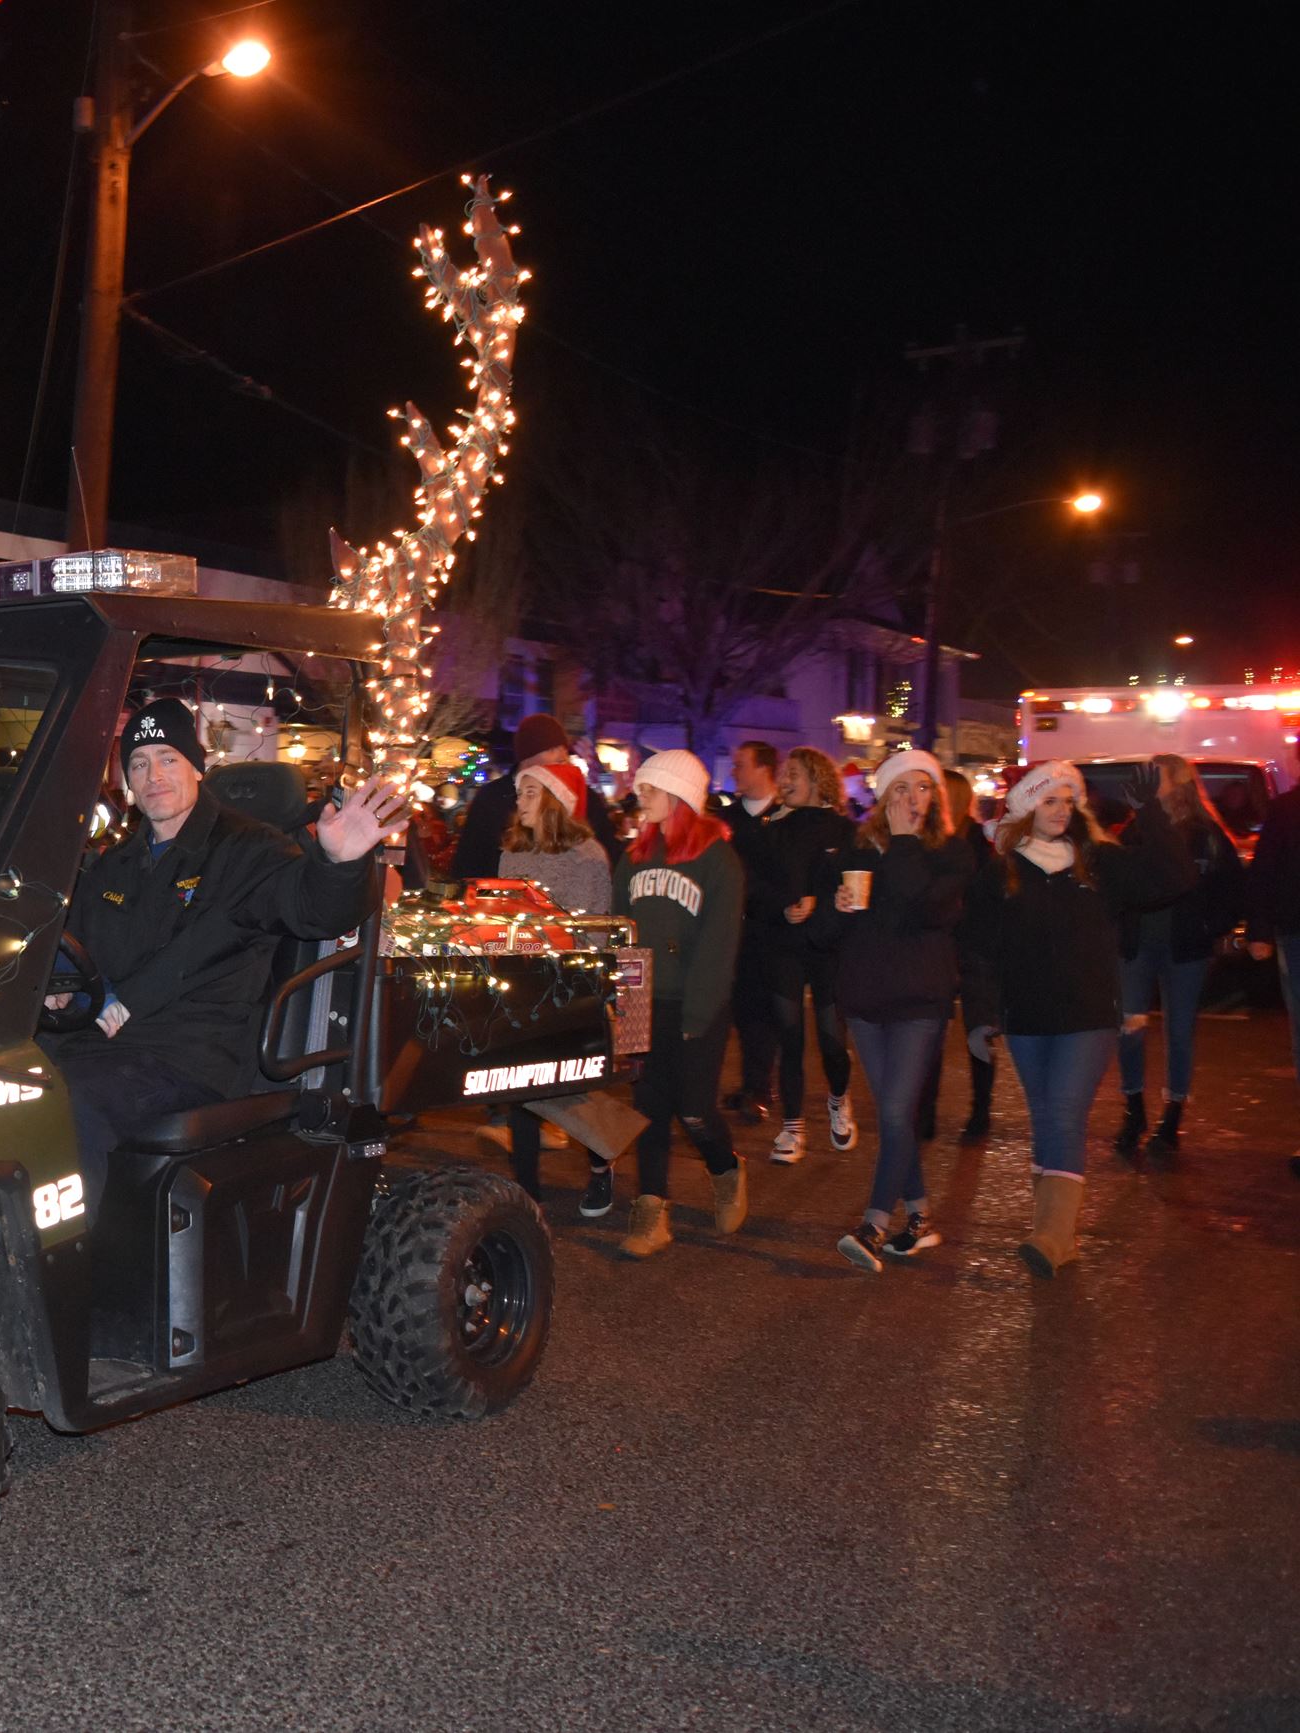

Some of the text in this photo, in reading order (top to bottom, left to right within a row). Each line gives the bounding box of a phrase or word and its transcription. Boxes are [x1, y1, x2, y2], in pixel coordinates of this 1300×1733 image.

[134, 729, 165, 742] SVVA
[463, 1055, 606, 1096] SOUTHAMPTON VILLAGE
[33, 1173, 85, 1229] 82
